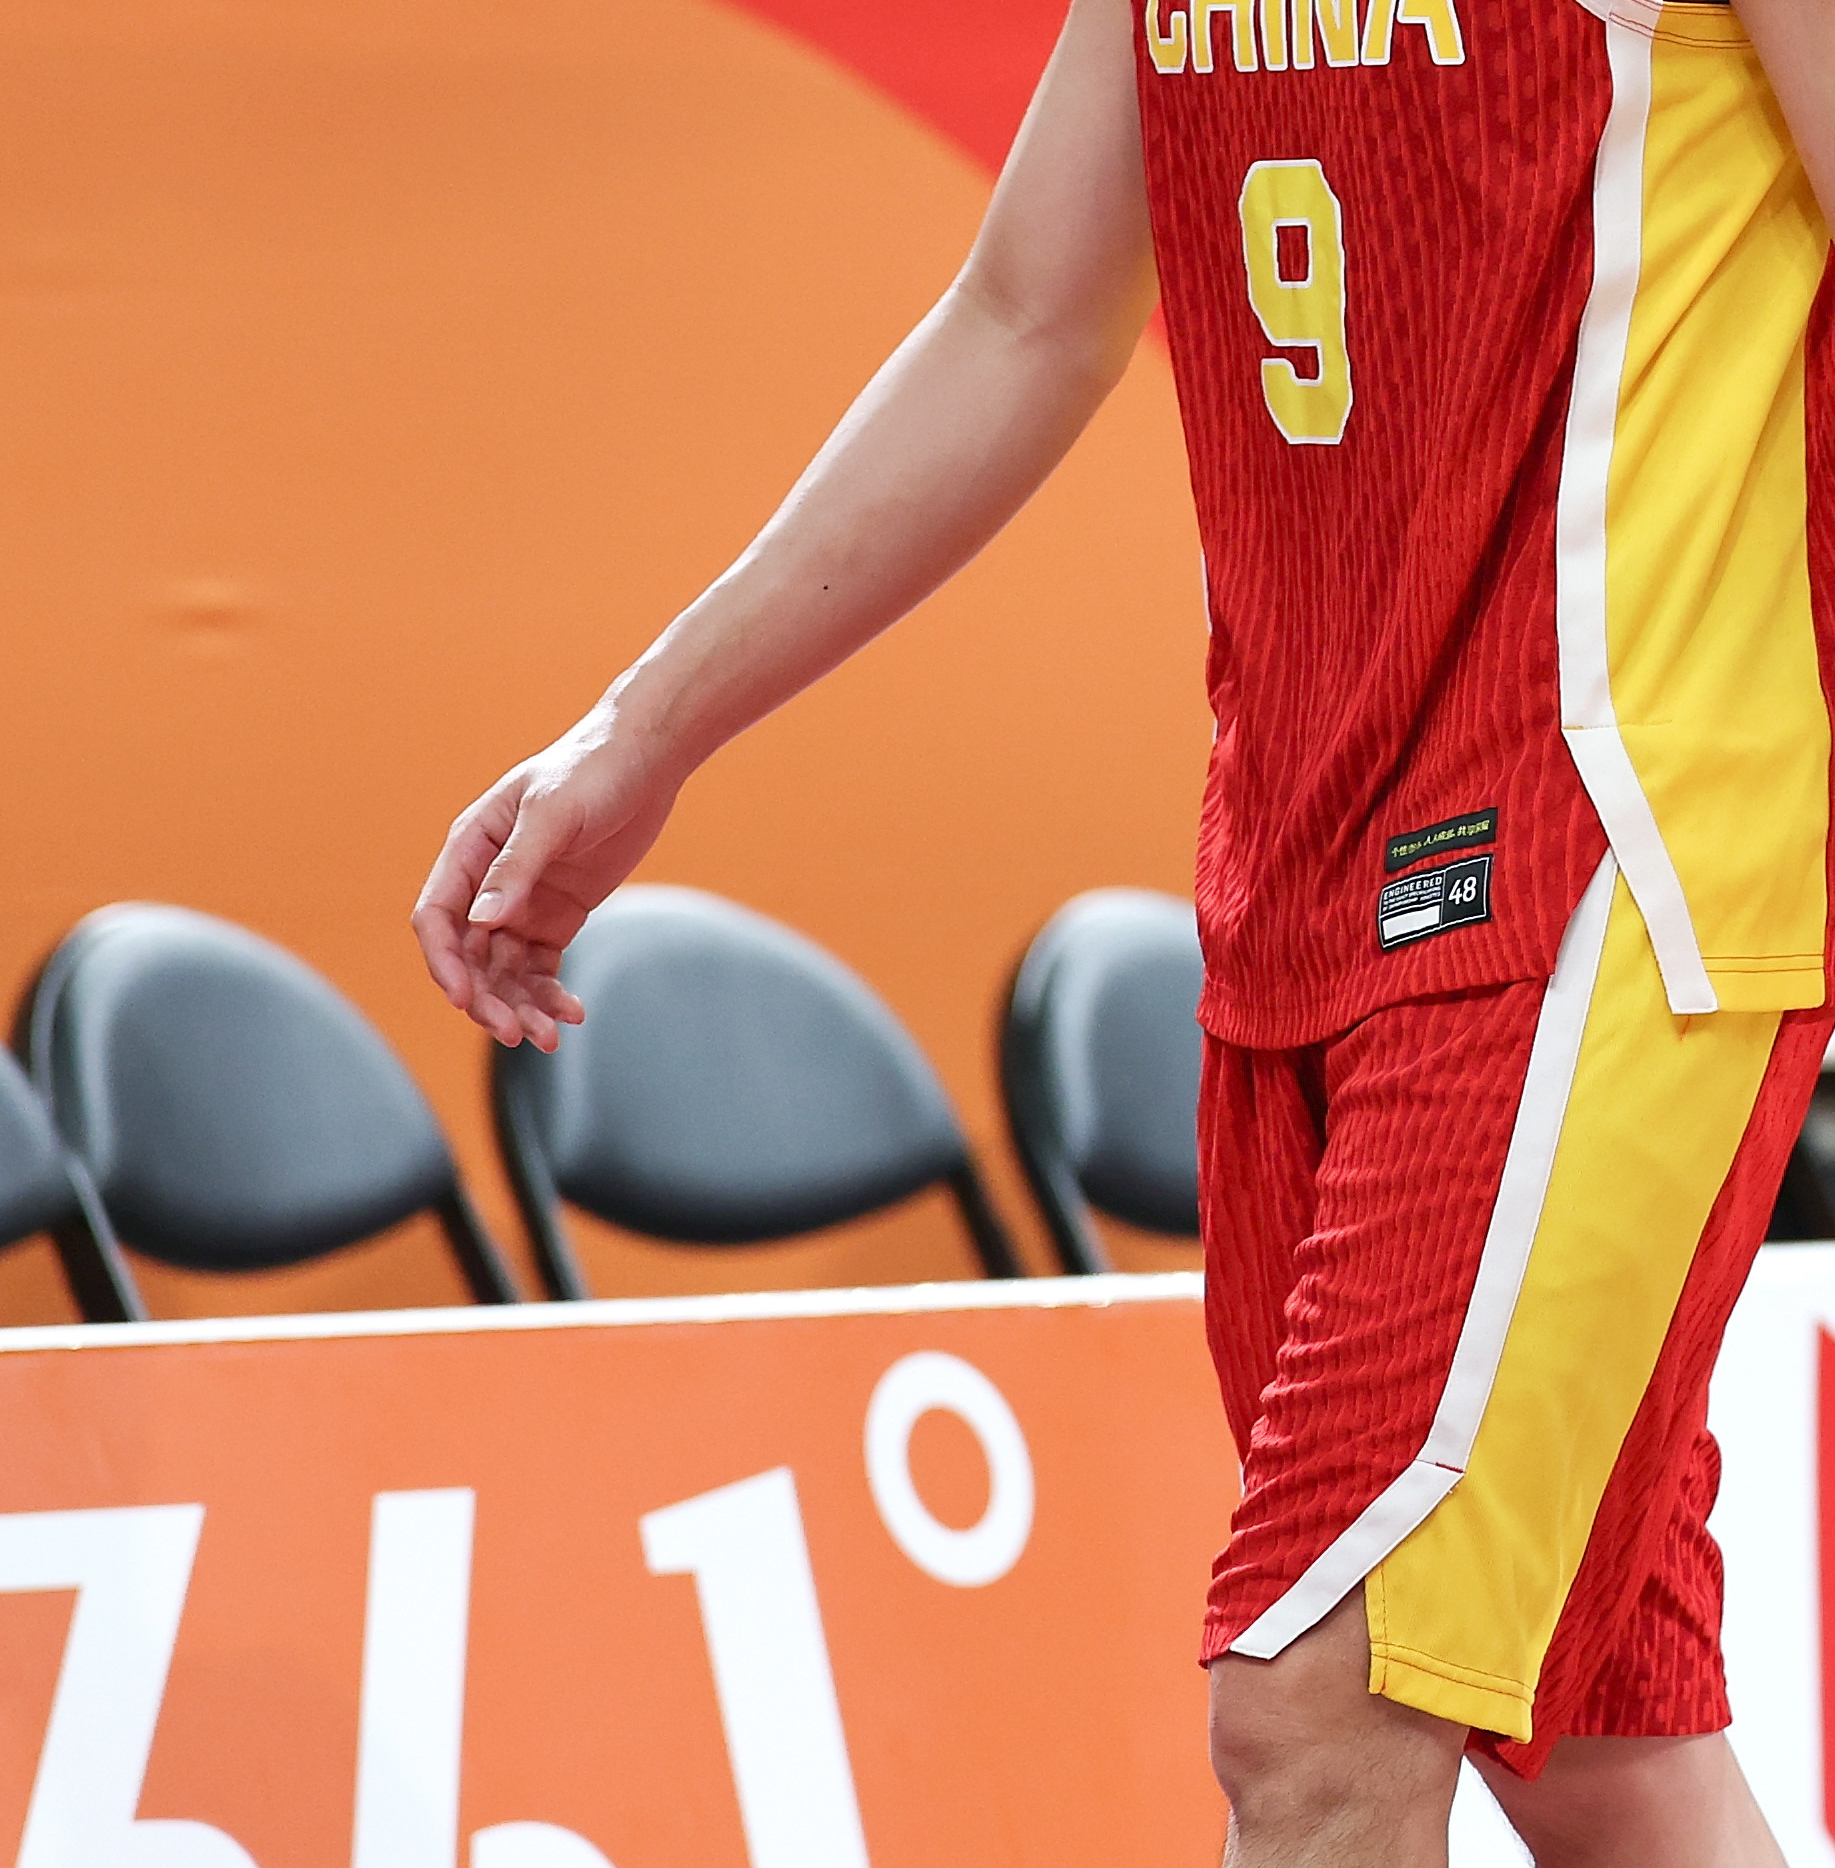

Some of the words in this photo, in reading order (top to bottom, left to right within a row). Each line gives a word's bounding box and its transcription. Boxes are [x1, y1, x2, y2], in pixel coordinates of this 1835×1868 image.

[1238, 158, 1354, 445] 9
[1383, 876, 1443, 900] ENGINEERED
[1448, 876, 1477, 905] 48
